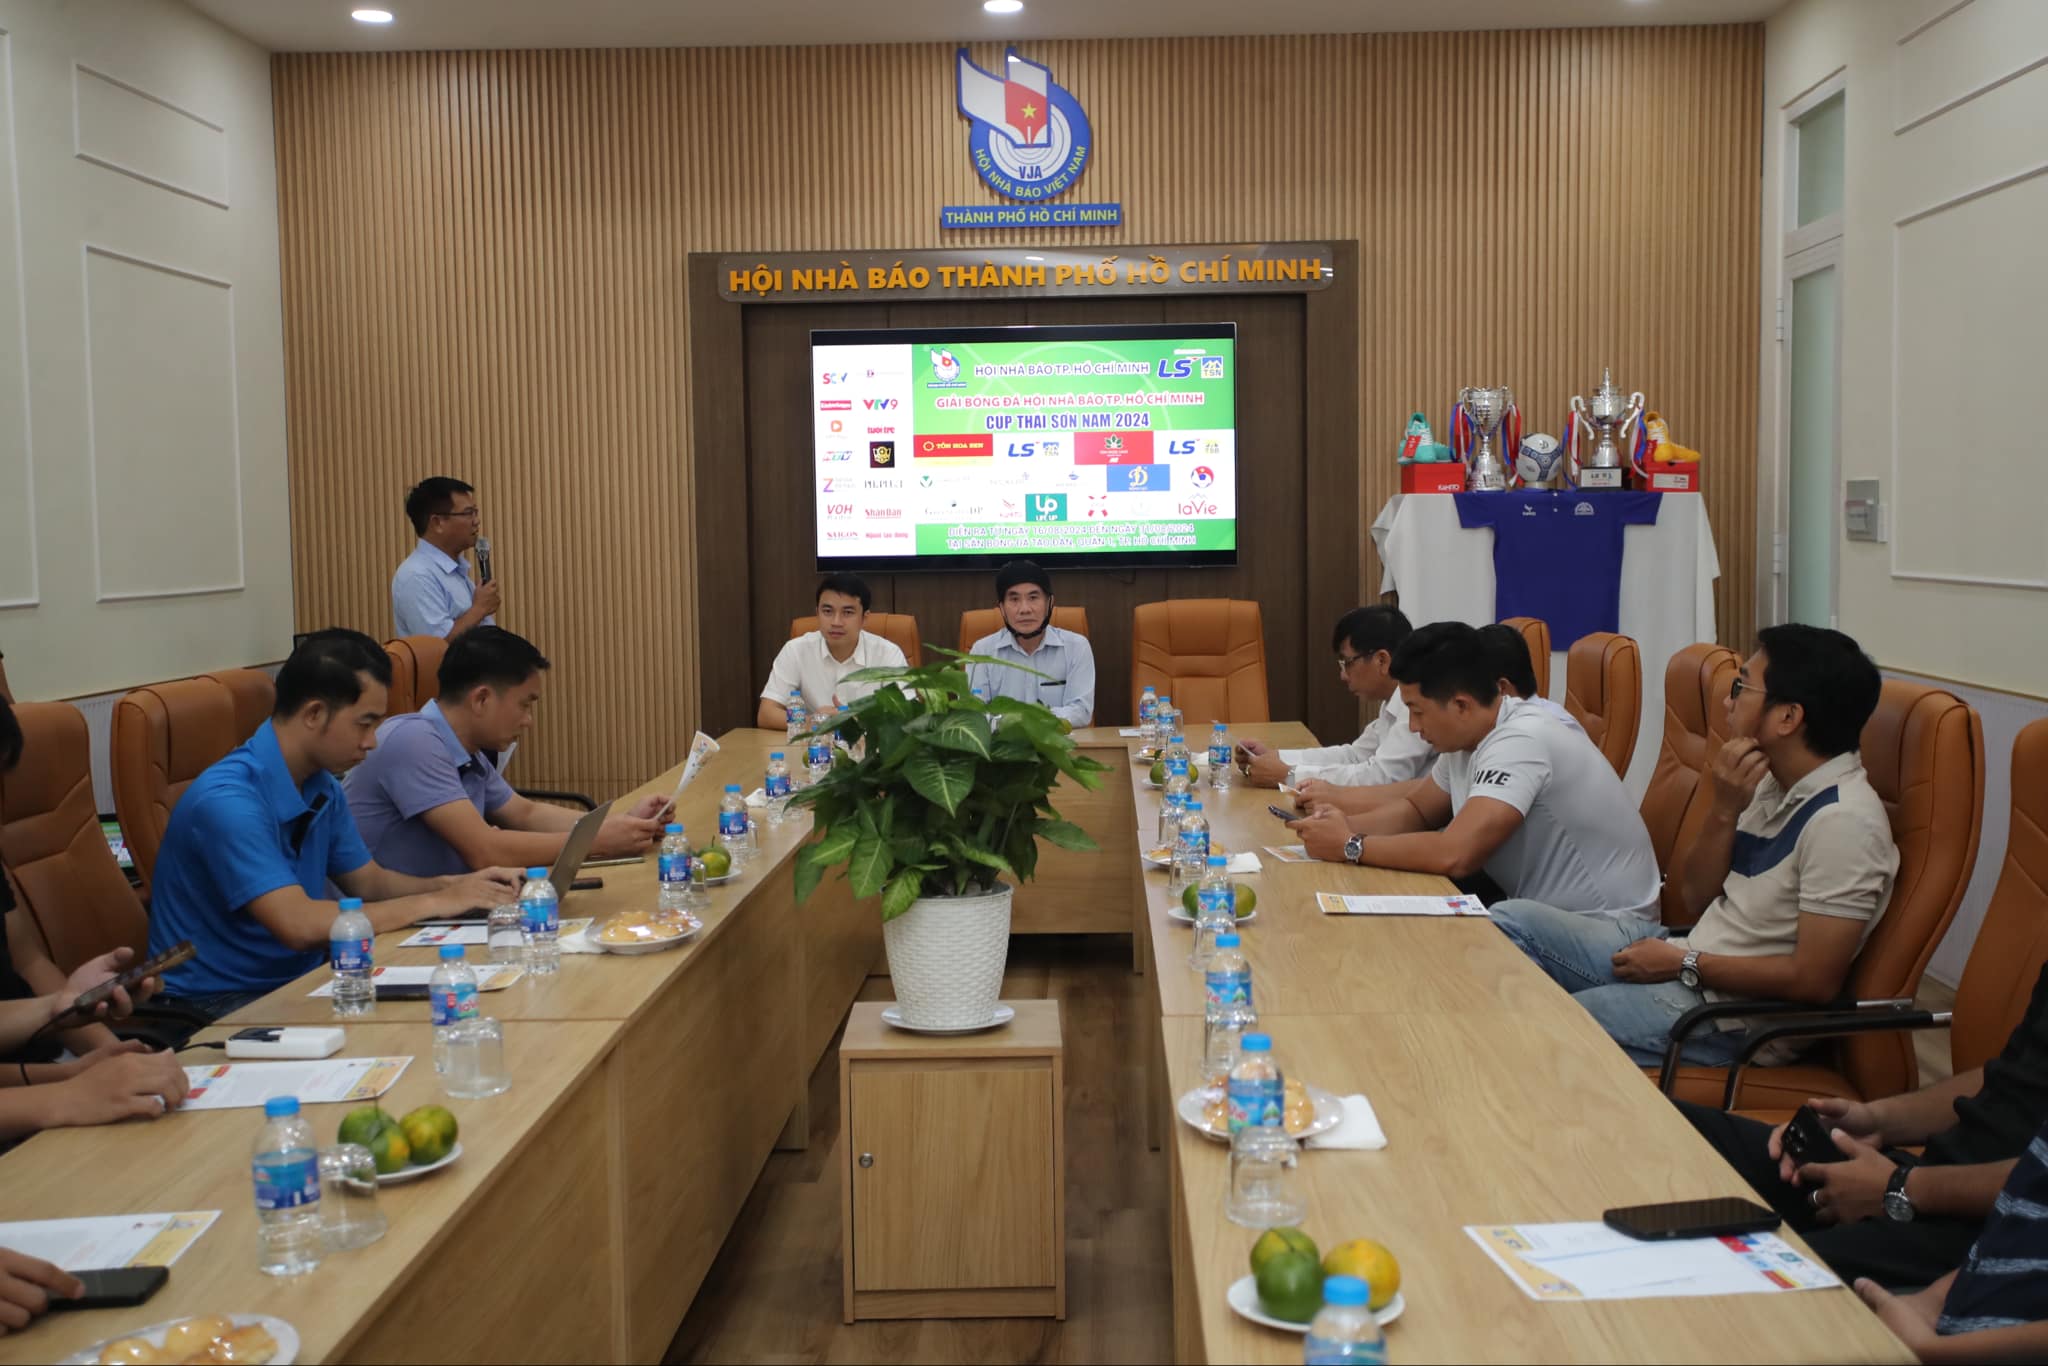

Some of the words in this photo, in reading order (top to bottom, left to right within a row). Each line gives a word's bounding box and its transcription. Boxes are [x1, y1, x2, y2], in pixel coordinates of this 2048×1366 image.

[976, 149, 991, 172] HỘI
[988, 172, 1011, 193] NHÀ
[1015, 184, 1041, 198] BÁO
[1044, 175, 1069, 194] VIỆT
[1072, 146, 1086, 175] NAM
[1019, 166, 1042, 179] VJA
[945, 209, 994, 224] THÀNH
[998, 208, 1026, 223] PHỐ
[1030, 207, 1050, 222] HỒ
[1053, 207, 1076, 222] CHÍ
[1080, 210, 1117, 221] MINH
[729, 264, 782, 296] HỘI
[792, 260, 859, 290] NHÀ
[868, 260, 930, 289] BÁO
[937, 259, 1047, 288] THÀNH
[1055, 255, 1118, 286] PHỐ
[1126, 254, 1171, 284] HỒ
[1179, 254, 1232, 283] CHÍ
[1238, 258, 1321, 281] MINH
[1117, 364, 1149, 373] MINH
[1158, 359, 1192, 378] LS
[1170, 394, 1203, 403] MINH
[1082, 413, 1111, 428] NAM
[1115, 412, 1150, 428] 2024
[1008, 443, 1035, 457] LS
[1169, 440, 1196, 454] LS
[827, 503, 853, 515] VOH
[1178, 500, 1218, 515] laVie
